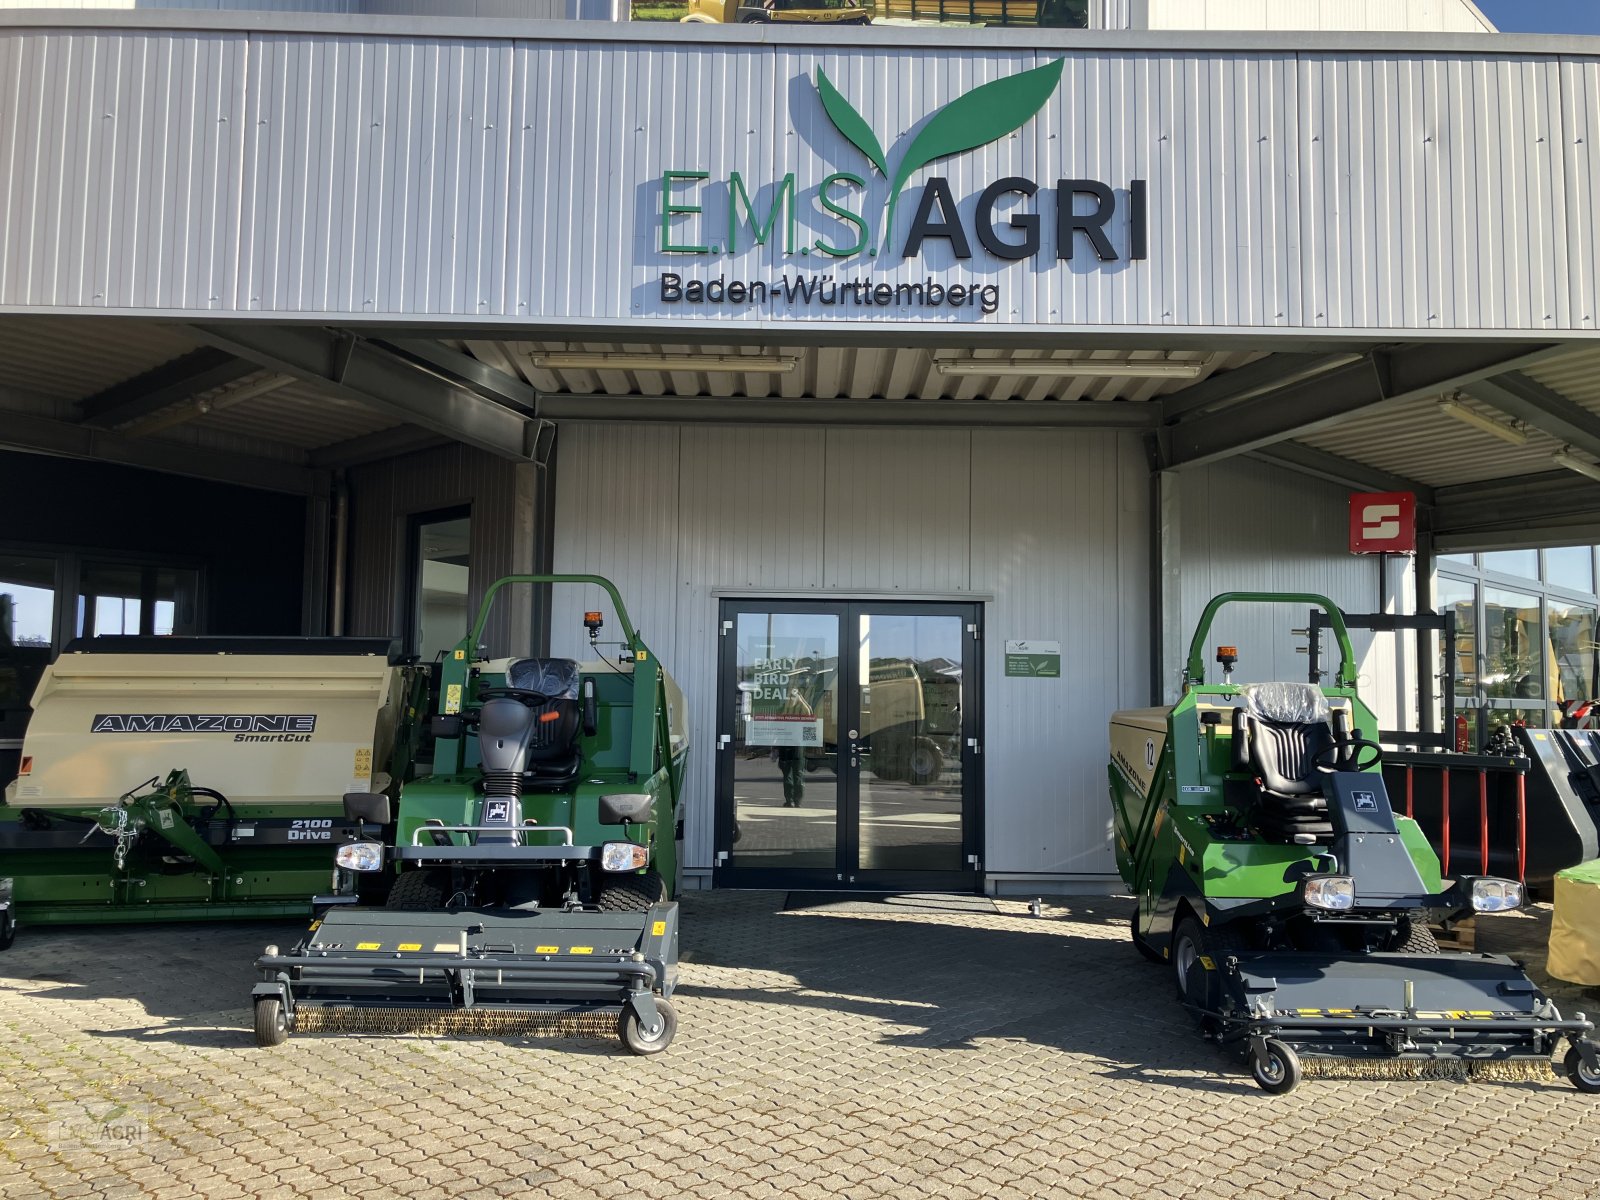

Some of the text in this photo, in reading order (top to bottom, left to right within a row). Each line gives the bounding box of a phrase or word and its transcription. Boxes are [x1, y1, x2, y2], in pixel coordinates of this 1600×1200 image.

[902, 176, 1147, 261] AGRI
[661, 273, 1000, 314] Baden-Württemberg
[754, 658, 797, 670] EARLY
[753, 673, 789, 685] BIRD
[93, 715, 315, 732] AMAZONE
[233, 733, 312, 743] SmartCut
[1146, 742, 1154, 765] 12
[1116, 750, 1146, 793] AMAZONE
[291, 819, 333, 828] 2100
[287, 831, 331, 840] Drive
